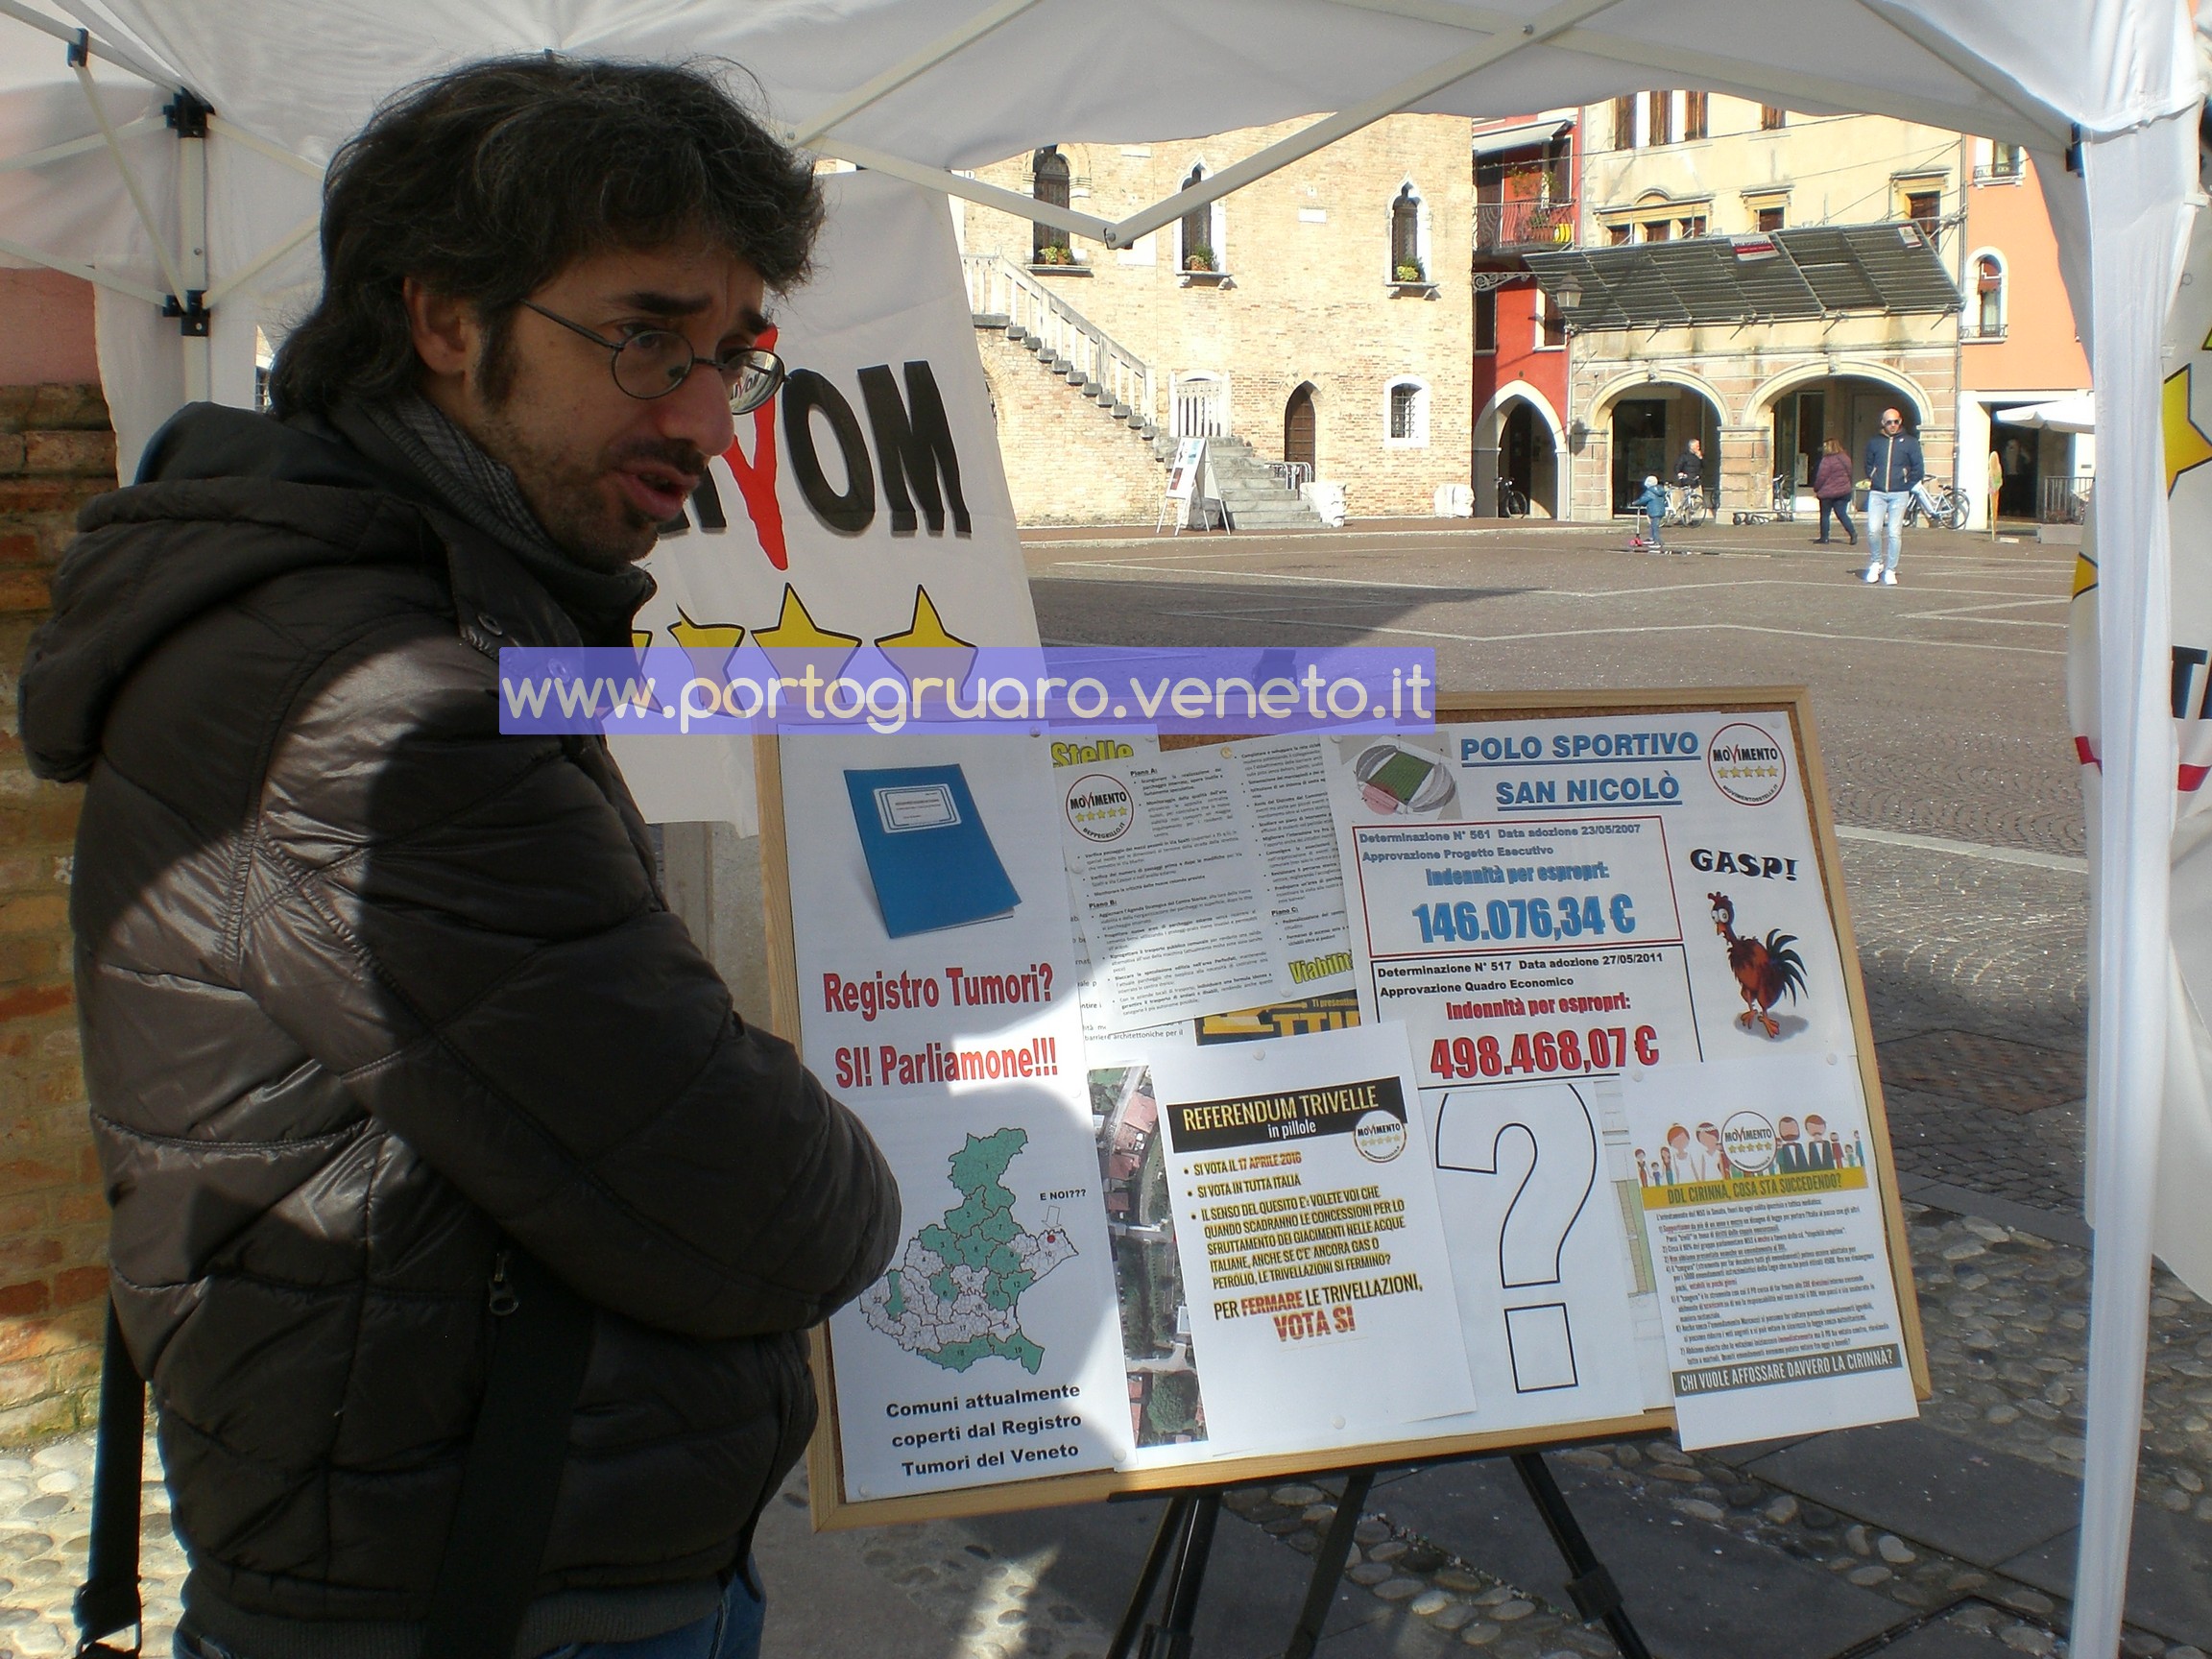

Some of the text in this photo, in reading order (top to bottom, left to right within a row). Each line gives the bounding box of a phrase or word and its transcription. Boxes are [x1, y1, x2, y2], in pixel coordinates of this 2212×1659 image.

[1050, 739, 1134, 767] Stelle
[1460, 732, 1699, 761] POLO SPORTIVO
[1713, 744, 1778, 763] MOVIMENTO
[1070, 790, 1127, 809] MOVIMENTO
[1496, 770, 1679, 805] SAN NICOLÒ
[1082, 822, 1126, 839] BEPPEGRILLO.IT
[1359, 830, 1450, 844] Determinazione
[1498, 828, 1526, 839] Data
[1527, 826, 1578, 838] adozione
[1580, 824, 1641, 837] 23/05/2007
[1362, 845, 1554, 864] Approvazione Progetto Esecutivo
[1690, 849, 1799, 881] GASP!
[1425, 861, 1610, 887] Indennità per espropri:
[1089, 899, 1118, 909] Piano B:
[1271, 907, 1290, 916] Piano
[1411, 893, 1636, 944] 146.076,34 €
[1378, 962, 1472, 978] Determinazione
[1490, 960, 1512, 973] 517
[1519, 958, 1547, 971] Data
[1549, 954, 1600, 969] adozione
[1602, 952, 1664, 966] 27/05/2011
[823, 970, 940, 1022] Registro
[946, 963, 1054, 1007] Tumori?
[1380, 975, 1575, 998] Approvazione Quadro Economico
[1446, 991, 1631, 1021] Indennità per espropri:
[1113, 1029, 1165, 1040] architettoniche
[835, 1037, 1058, 1089] SI! Parliamone!!!
[1430, 1024, 1660, 1079] 498.468,07 €
[1183, 1086, 1379, 1131] REFERENDUM TRIVELLE
[1267, 1118, 1316, 1140] in pillole
[1357, 1122, 1401, 1137] MOVIMENTO
[1725, 1126, 1772, 1142] MOVIMENTO
[1193, 1151, 1302, 1176] SI VOTA IL 17 APRILE 2016
[1040, 1189, 1087, 1201] E NOI???
[1197, 1172, 1302, 1198] SI VOTA IN TUTTA ITALIA
[1668, 1188, 1687, 1204] DDL
[1733, 1180, 1758, 1198] COSA
[1760, 1178, 1778, 1195] STA
[1779, 1172, 1842, 1192] SUCCEDENDO?
[1201, 1208, 1211, 1221] IL
[1212, 1205, 1240, 1220] SENSO
[1242, 1202, 1259, 1216] DEL
[1260, 1197, 1298, 1214] QUESITO
[1310, 1190, 1344, 1207] VOLETE
[1343, 1187, 1360, 1202] VOI
[1360, 1185, 1381, 1200] CHE
[1204, 1199, 1406, 1238] QUANDO SCADRANNO LE CONCESSIONI PER LO
[1207, 1214, 1406, 1256] SFRUTTAMENTO DEI GIACIMENTI NELLE ACQUE
[1210, 1255, 1251, 1273] ITALIANE,
[1252, 1251, 1283, 1268] ANCHE
[1284, 1249, 1295, 1262] SE
[1313, 1240, 1354, 1259] ANCORA
[1352, 1238, 1370, 1253] GAS
[1371, 1238, 1380, 1250] O
[1213, 1254, 1391, 1289] PETROLIO, LE TRIVELLAZIONI SI FERMINO?
[1214, 1273, 1423, 1321] PER FERMARE LE TRIVELLAZIONI,
[1273, 1304, 1356, 1342] VOTA SI
[1680, 1372, 1698, 1392] CHI
[1698, 1368, 1731, 1389] VUOLE
[1732, 1362, 1787, 1385] AFFOSSARE
[1787, 1357, 1831, 1377] DAVVERO
[1833, 1355, 1846, 1372] LA
[1847, 1347, 1894, 1370] CIRINNÀ?
[886, 1383, 1081, 1418] Comuni attualmente
[891, 1414, 1082, 1448] coperti dal Registro
[902, 1444, 1079, 1477] Tumori del Veneto
